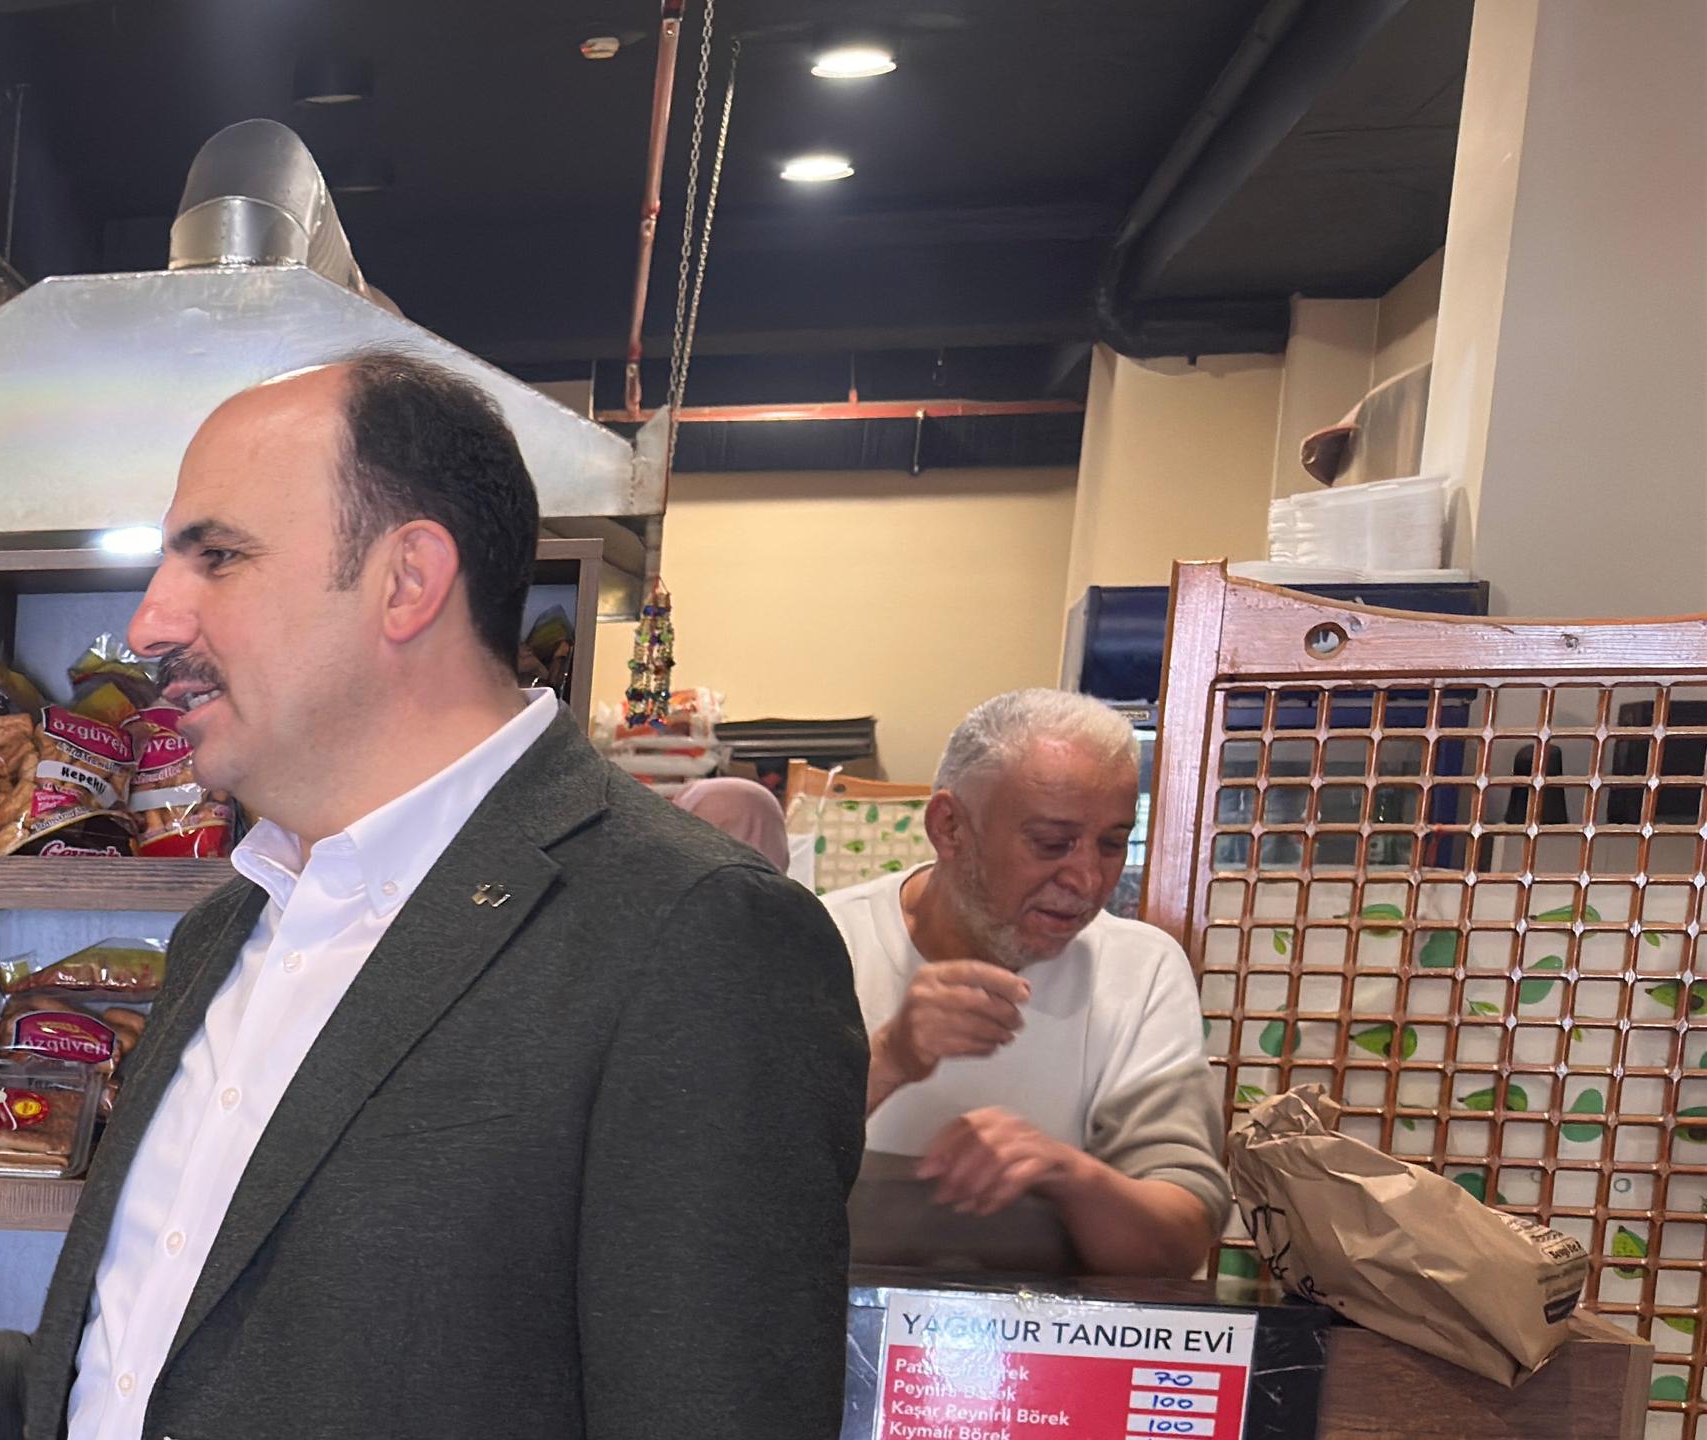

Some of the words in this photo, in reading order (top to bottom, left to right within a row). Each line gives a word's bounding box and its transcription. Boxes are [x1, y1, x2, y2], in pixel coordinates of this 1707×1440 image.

[53, 718, 128, 758] özgüven
[902, 1311, 1041, 1342] YAĞMUR
[1052, 1322, 1173, 1351] TANDIR
[1184, 1326, 1235, 1354] EVİ
[1154, 1371, 1193, 1387] 70
[1152, 1394, 1193, 1409] 100
[891, 1400, 941, 1419] Kaşar
[945, 1404, 1011, 1423] Peynirli
[1017, 1408, 1070, 1427] Börek
[889, 1421, 954, 1440] Kıymalı
[1149, 1418, 1194, 1433] 100
